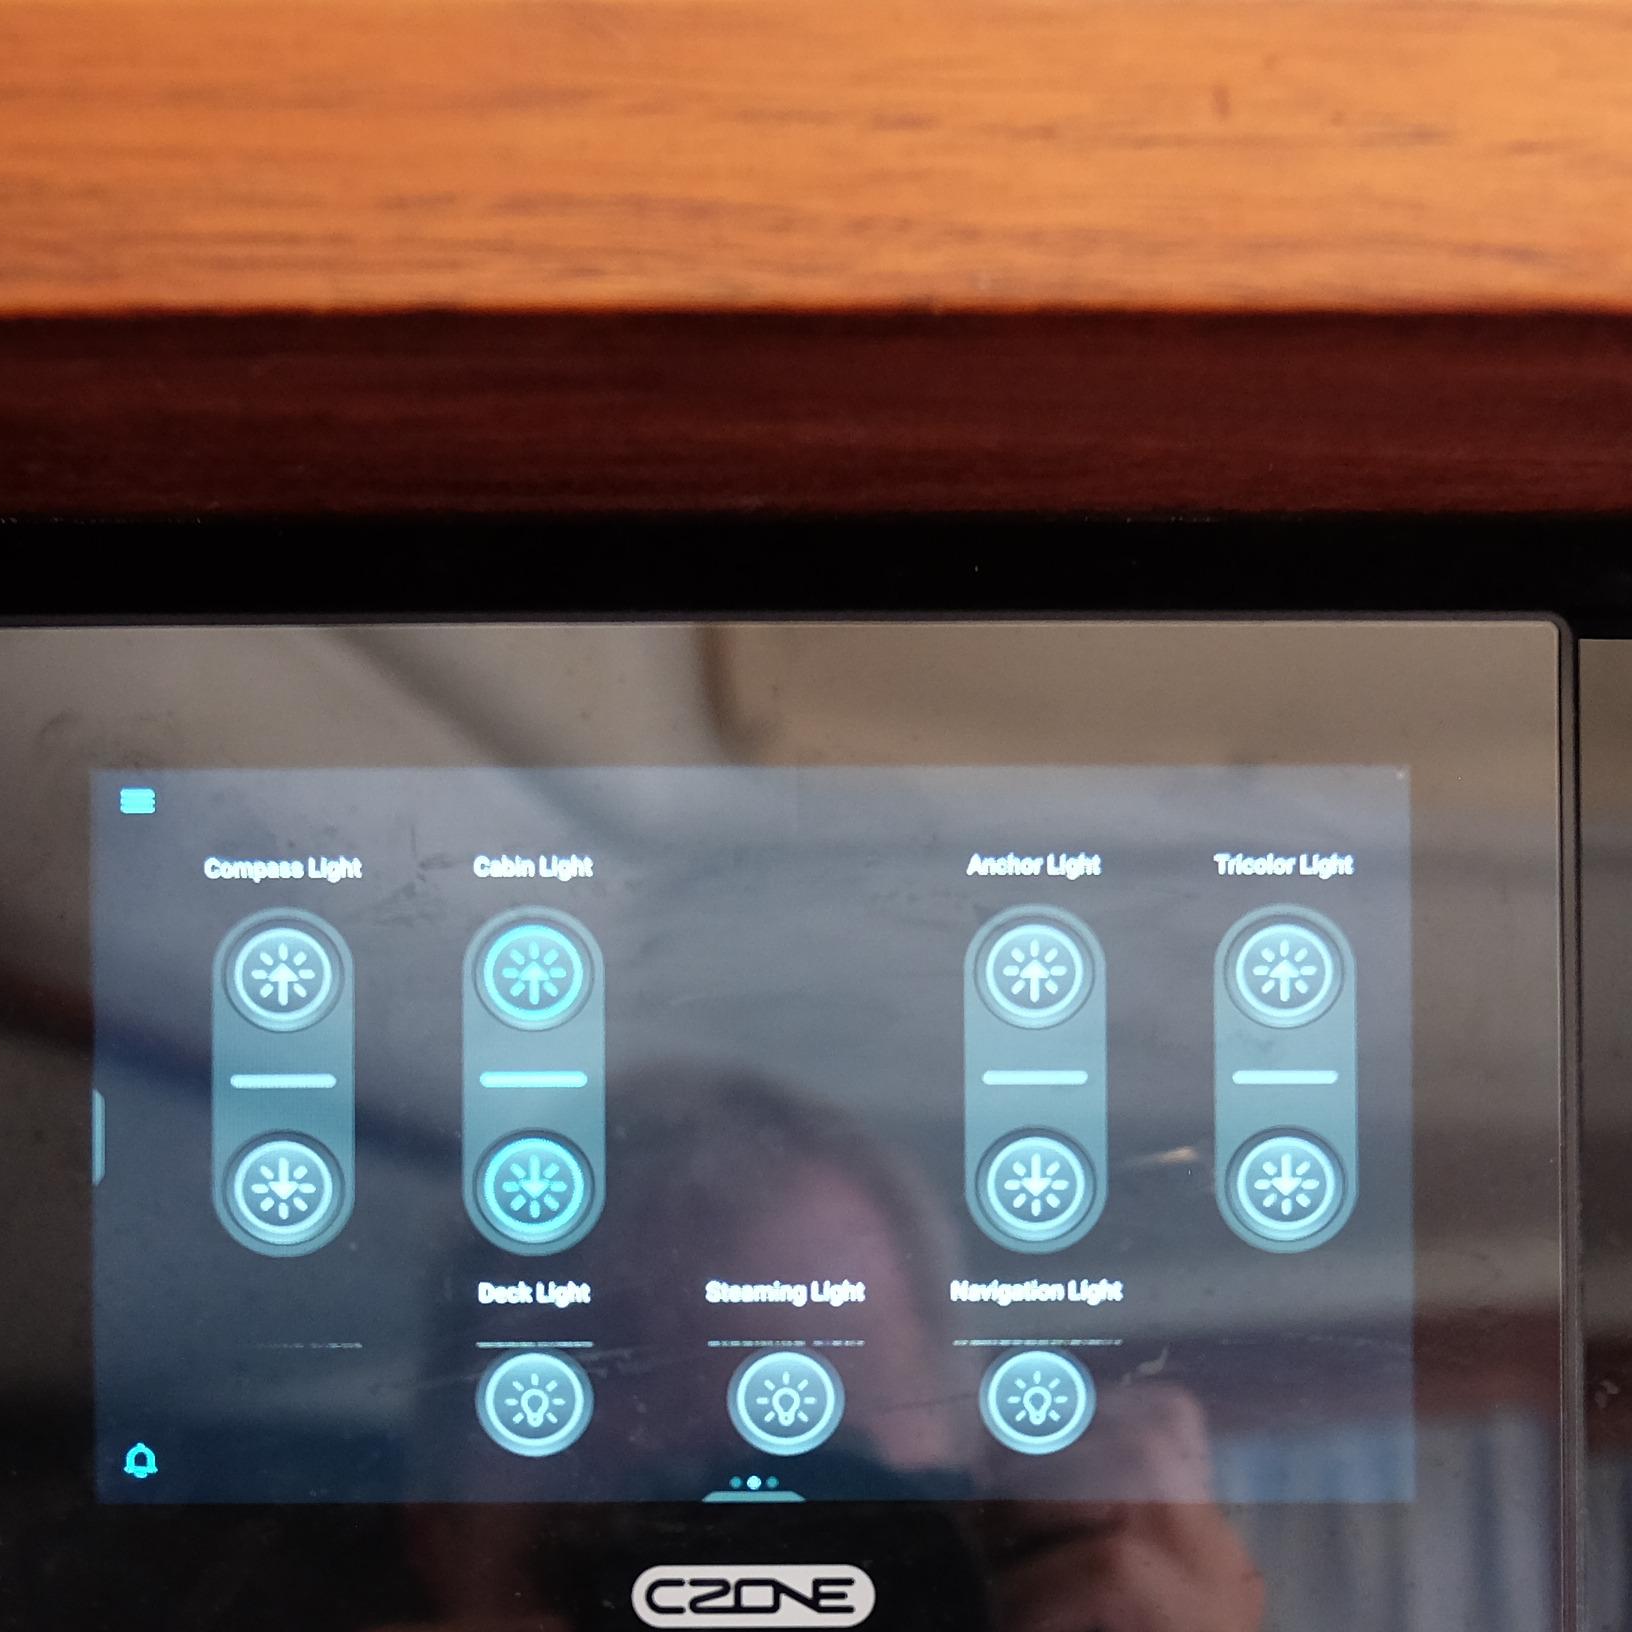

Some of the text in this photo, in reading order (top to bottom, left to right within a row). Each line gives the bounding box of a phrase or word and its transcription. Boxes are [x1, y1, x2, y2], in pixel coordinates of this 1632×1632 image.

[204, 856, 362, 883] Compass Light
[473, 855, 593, 881] Cabin Light
[967, 854, 1101, 880] Anchor Light
[1213, 854, 1354, 880] Tricolor Light
[478, 1282, 591, 1307] Deck Light
[705, 1281, 865, 1307] Steaming Light
[950, 1280, 1123, 1306] Navigation Light
